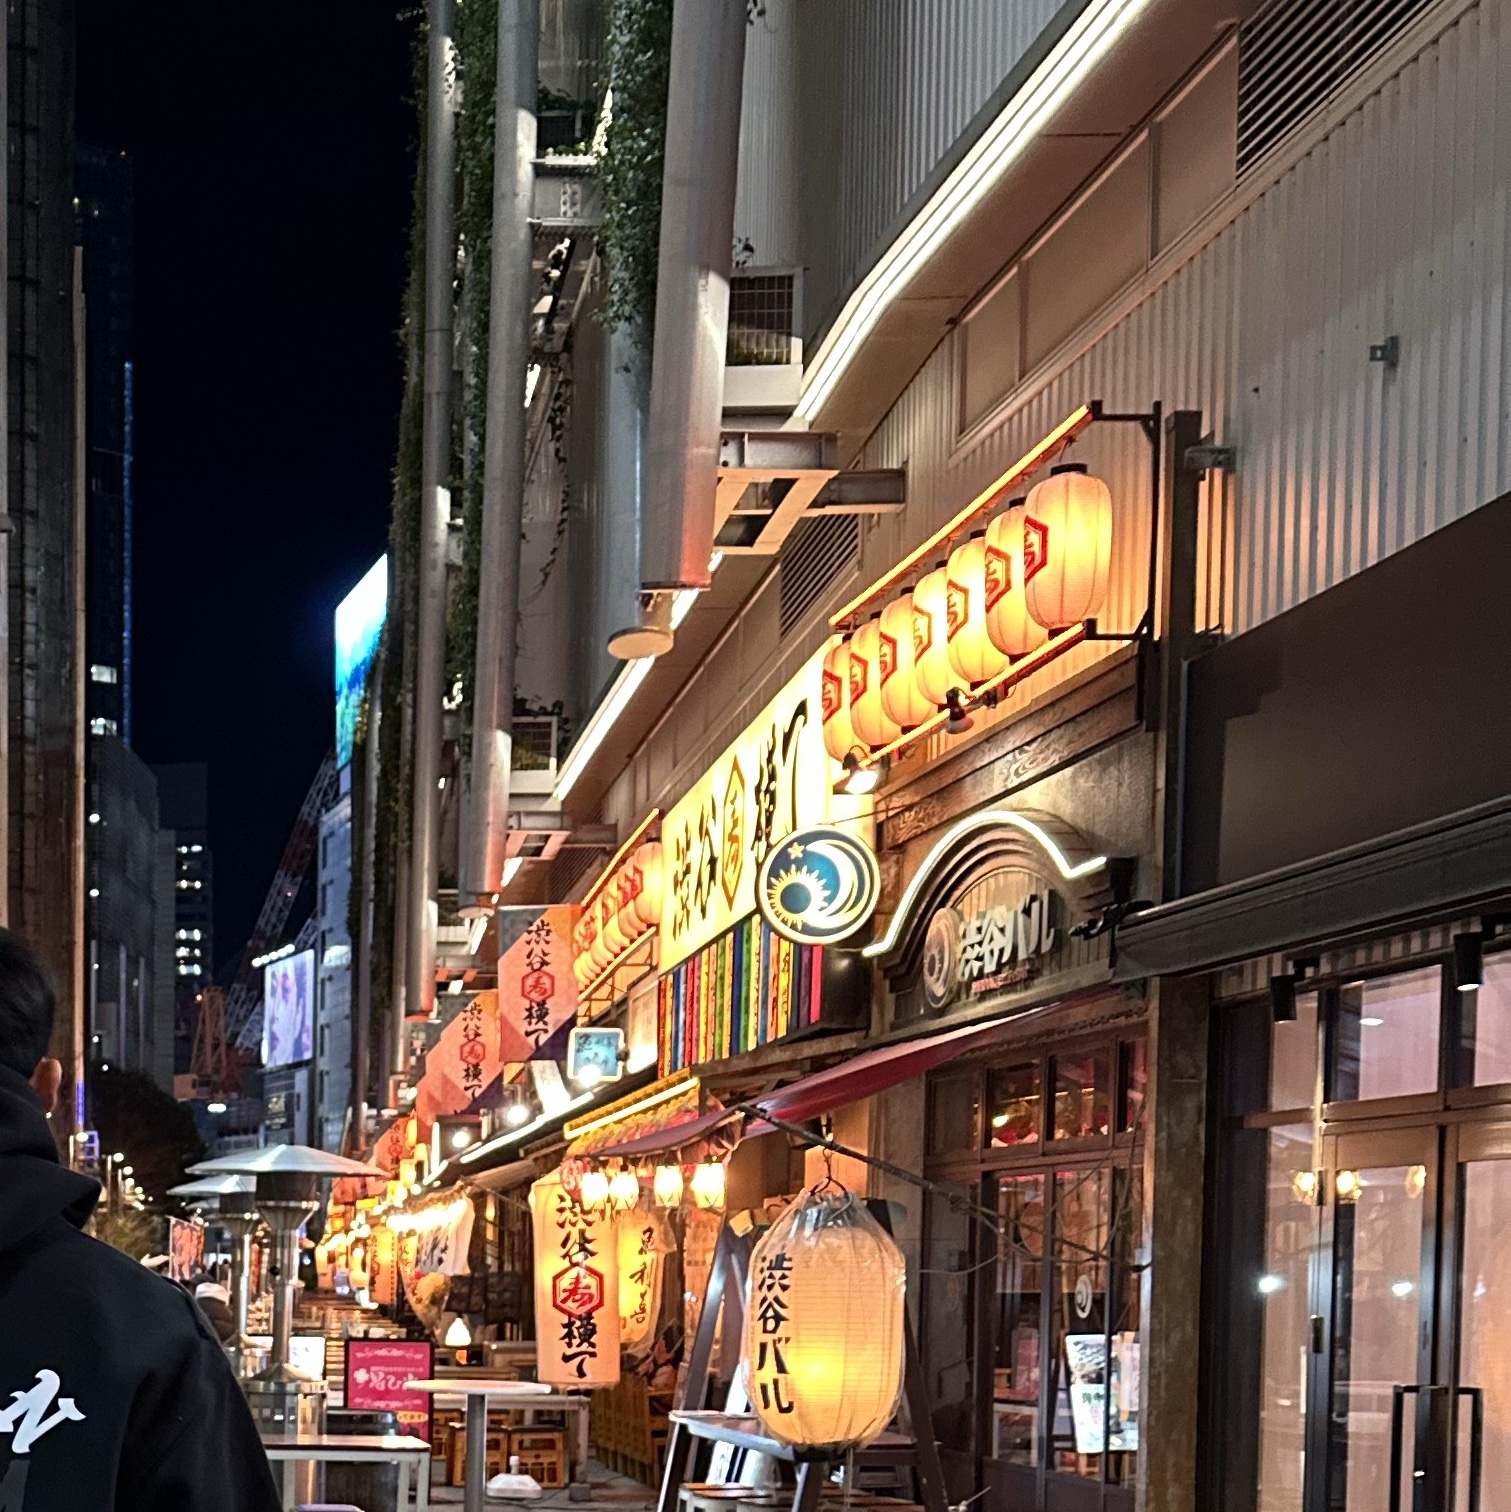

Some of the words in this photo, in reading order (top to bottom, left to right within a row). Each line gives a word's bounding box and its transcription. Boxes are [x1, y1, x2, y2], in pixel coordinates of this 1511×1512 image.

[958, 888, 1055, 982] 渋谷バル
[756, 1252, 795, 1414] 渋谷バル
